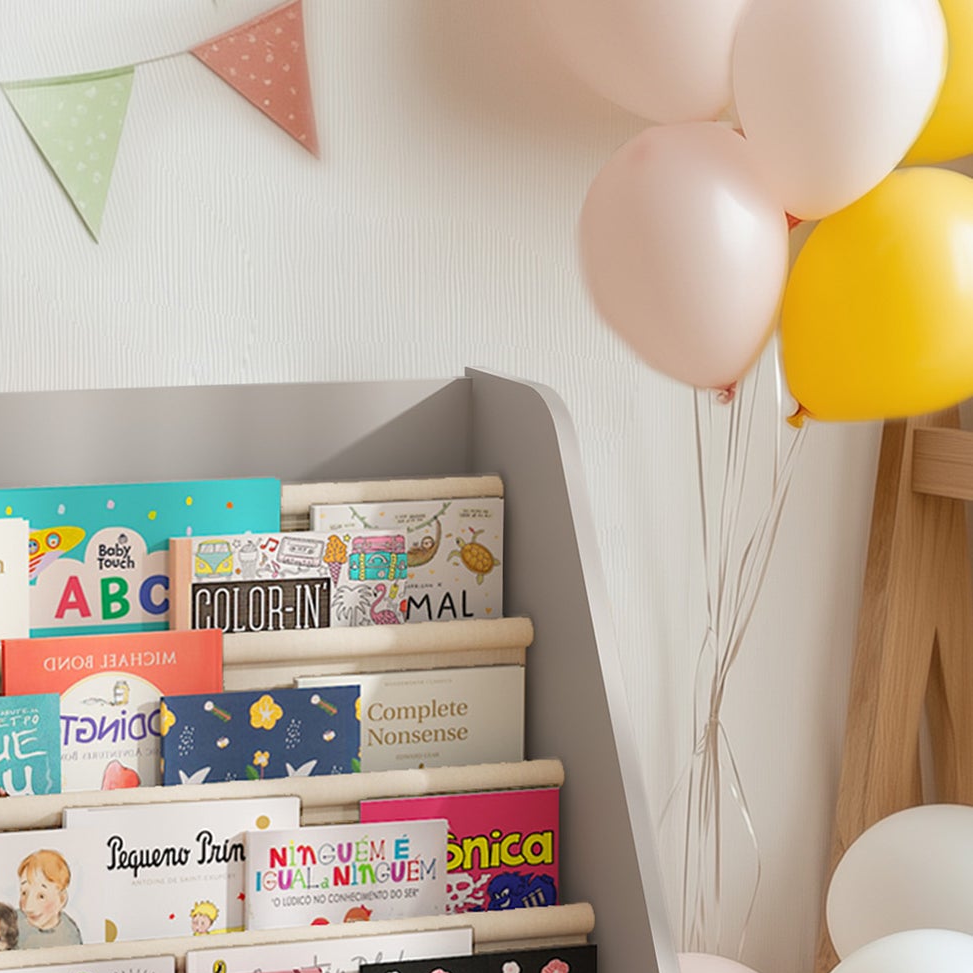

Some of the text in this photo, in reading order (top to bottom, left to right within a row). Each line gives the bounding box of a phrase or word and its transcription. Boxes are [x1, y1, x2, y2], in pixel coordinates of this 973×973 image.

[98, 543, 132, 560] Baby
[97, 557, 135, 570] Touch
[367, 699, 469, 724] Complete
[367, 725, 469, 747] Nonsense
[107, 835, 191, 878] Pequeno
[394, 834, 410, 860] É
[255, 866, 320, 892] IGUAL
[313, 894, 326, 904] NO
[390, 889, 402, 899] DO
